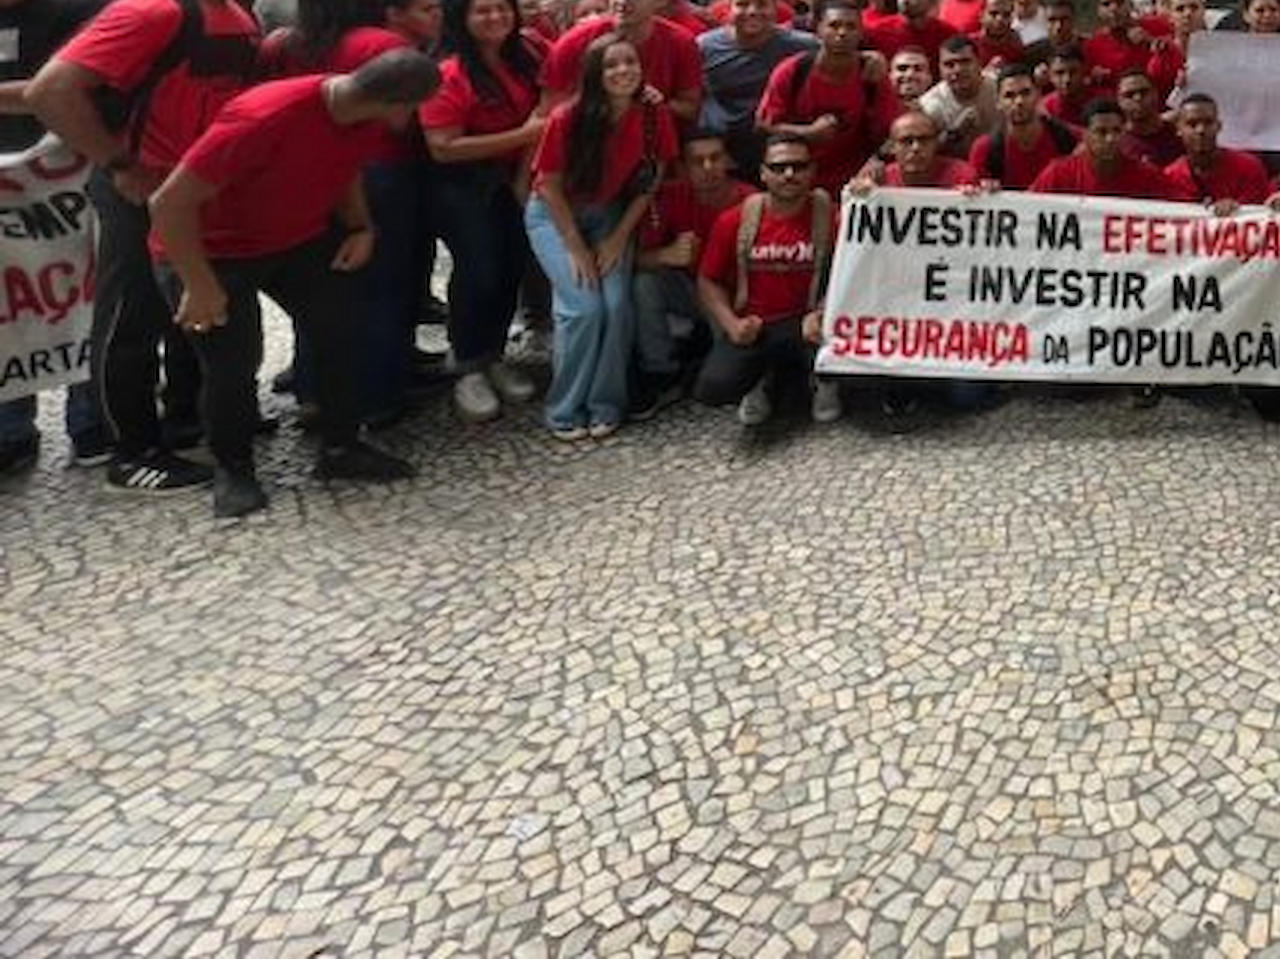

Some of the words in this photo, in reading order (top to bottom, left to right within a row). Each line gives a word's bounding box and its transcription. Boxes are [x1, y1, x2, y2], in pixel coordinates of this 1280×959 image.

[847, 203, 1018, 249] INVESTIR
[1036, 212, 1082, 251] NA
[969, 264, 1147, 312] INVESTIR
[1172, 274, 1223, 313] NA
[832, 316, 1030, 368] SEGURANÇA
[1043, 332, 1070, 365] DA
